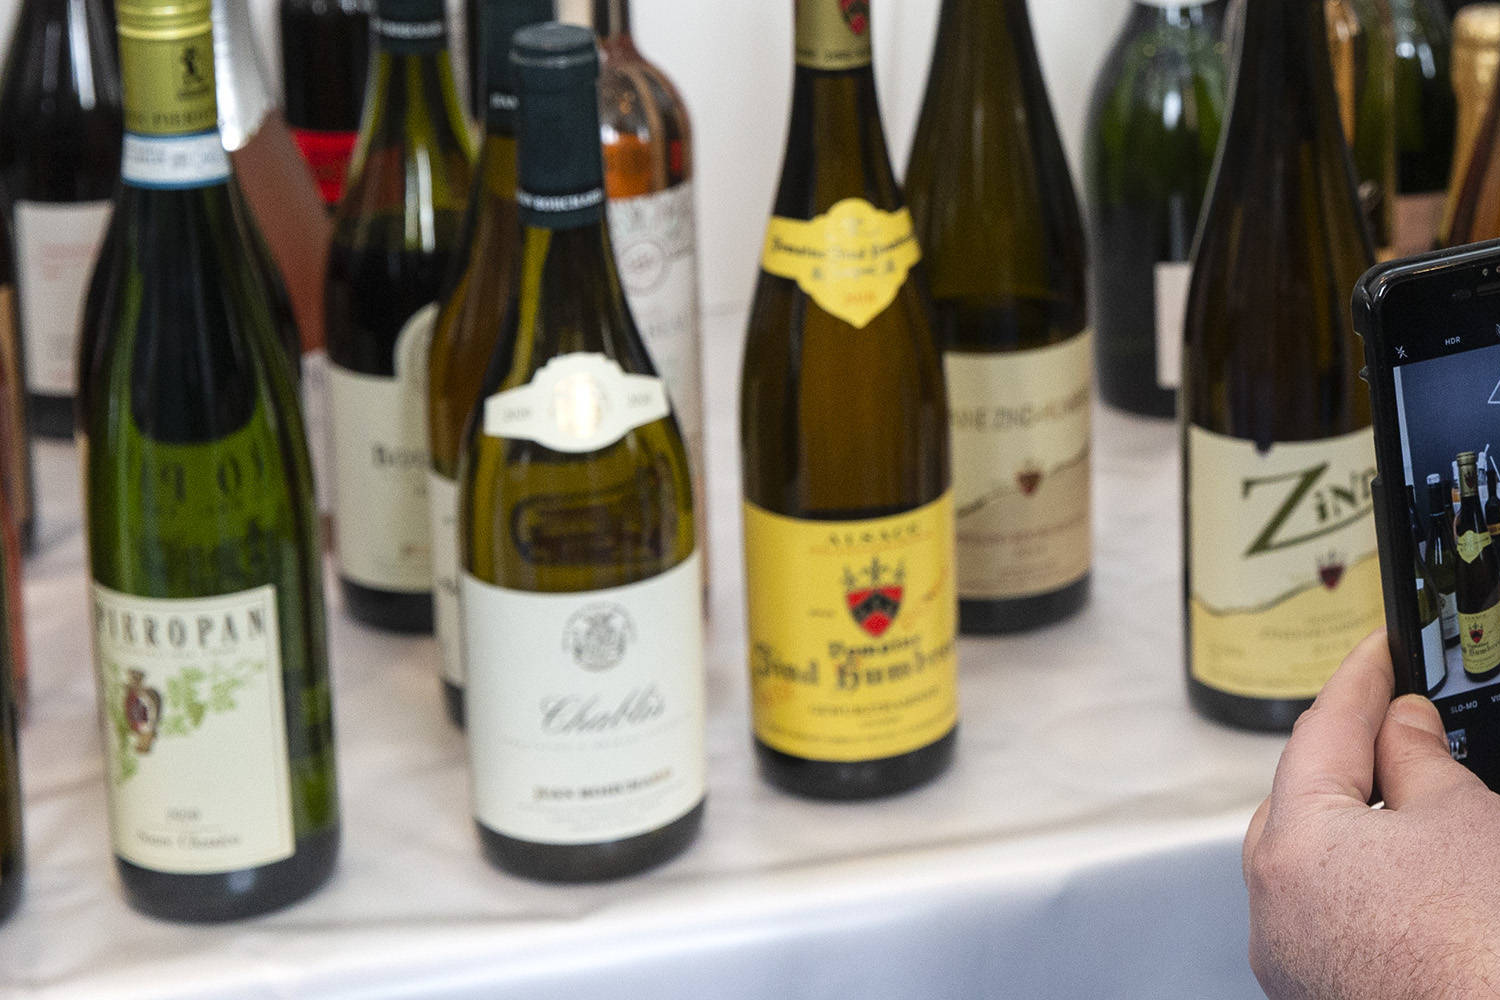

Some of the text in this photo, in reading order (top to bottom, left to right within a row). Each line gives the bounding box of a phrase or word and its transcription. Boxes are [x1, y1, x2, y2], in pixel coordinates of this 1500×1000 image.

[1444, 336, 1461, 346] HDR
[539, 682, 666, 736] Chablis
[1451, 700, 1478, 714] SLO-MO
